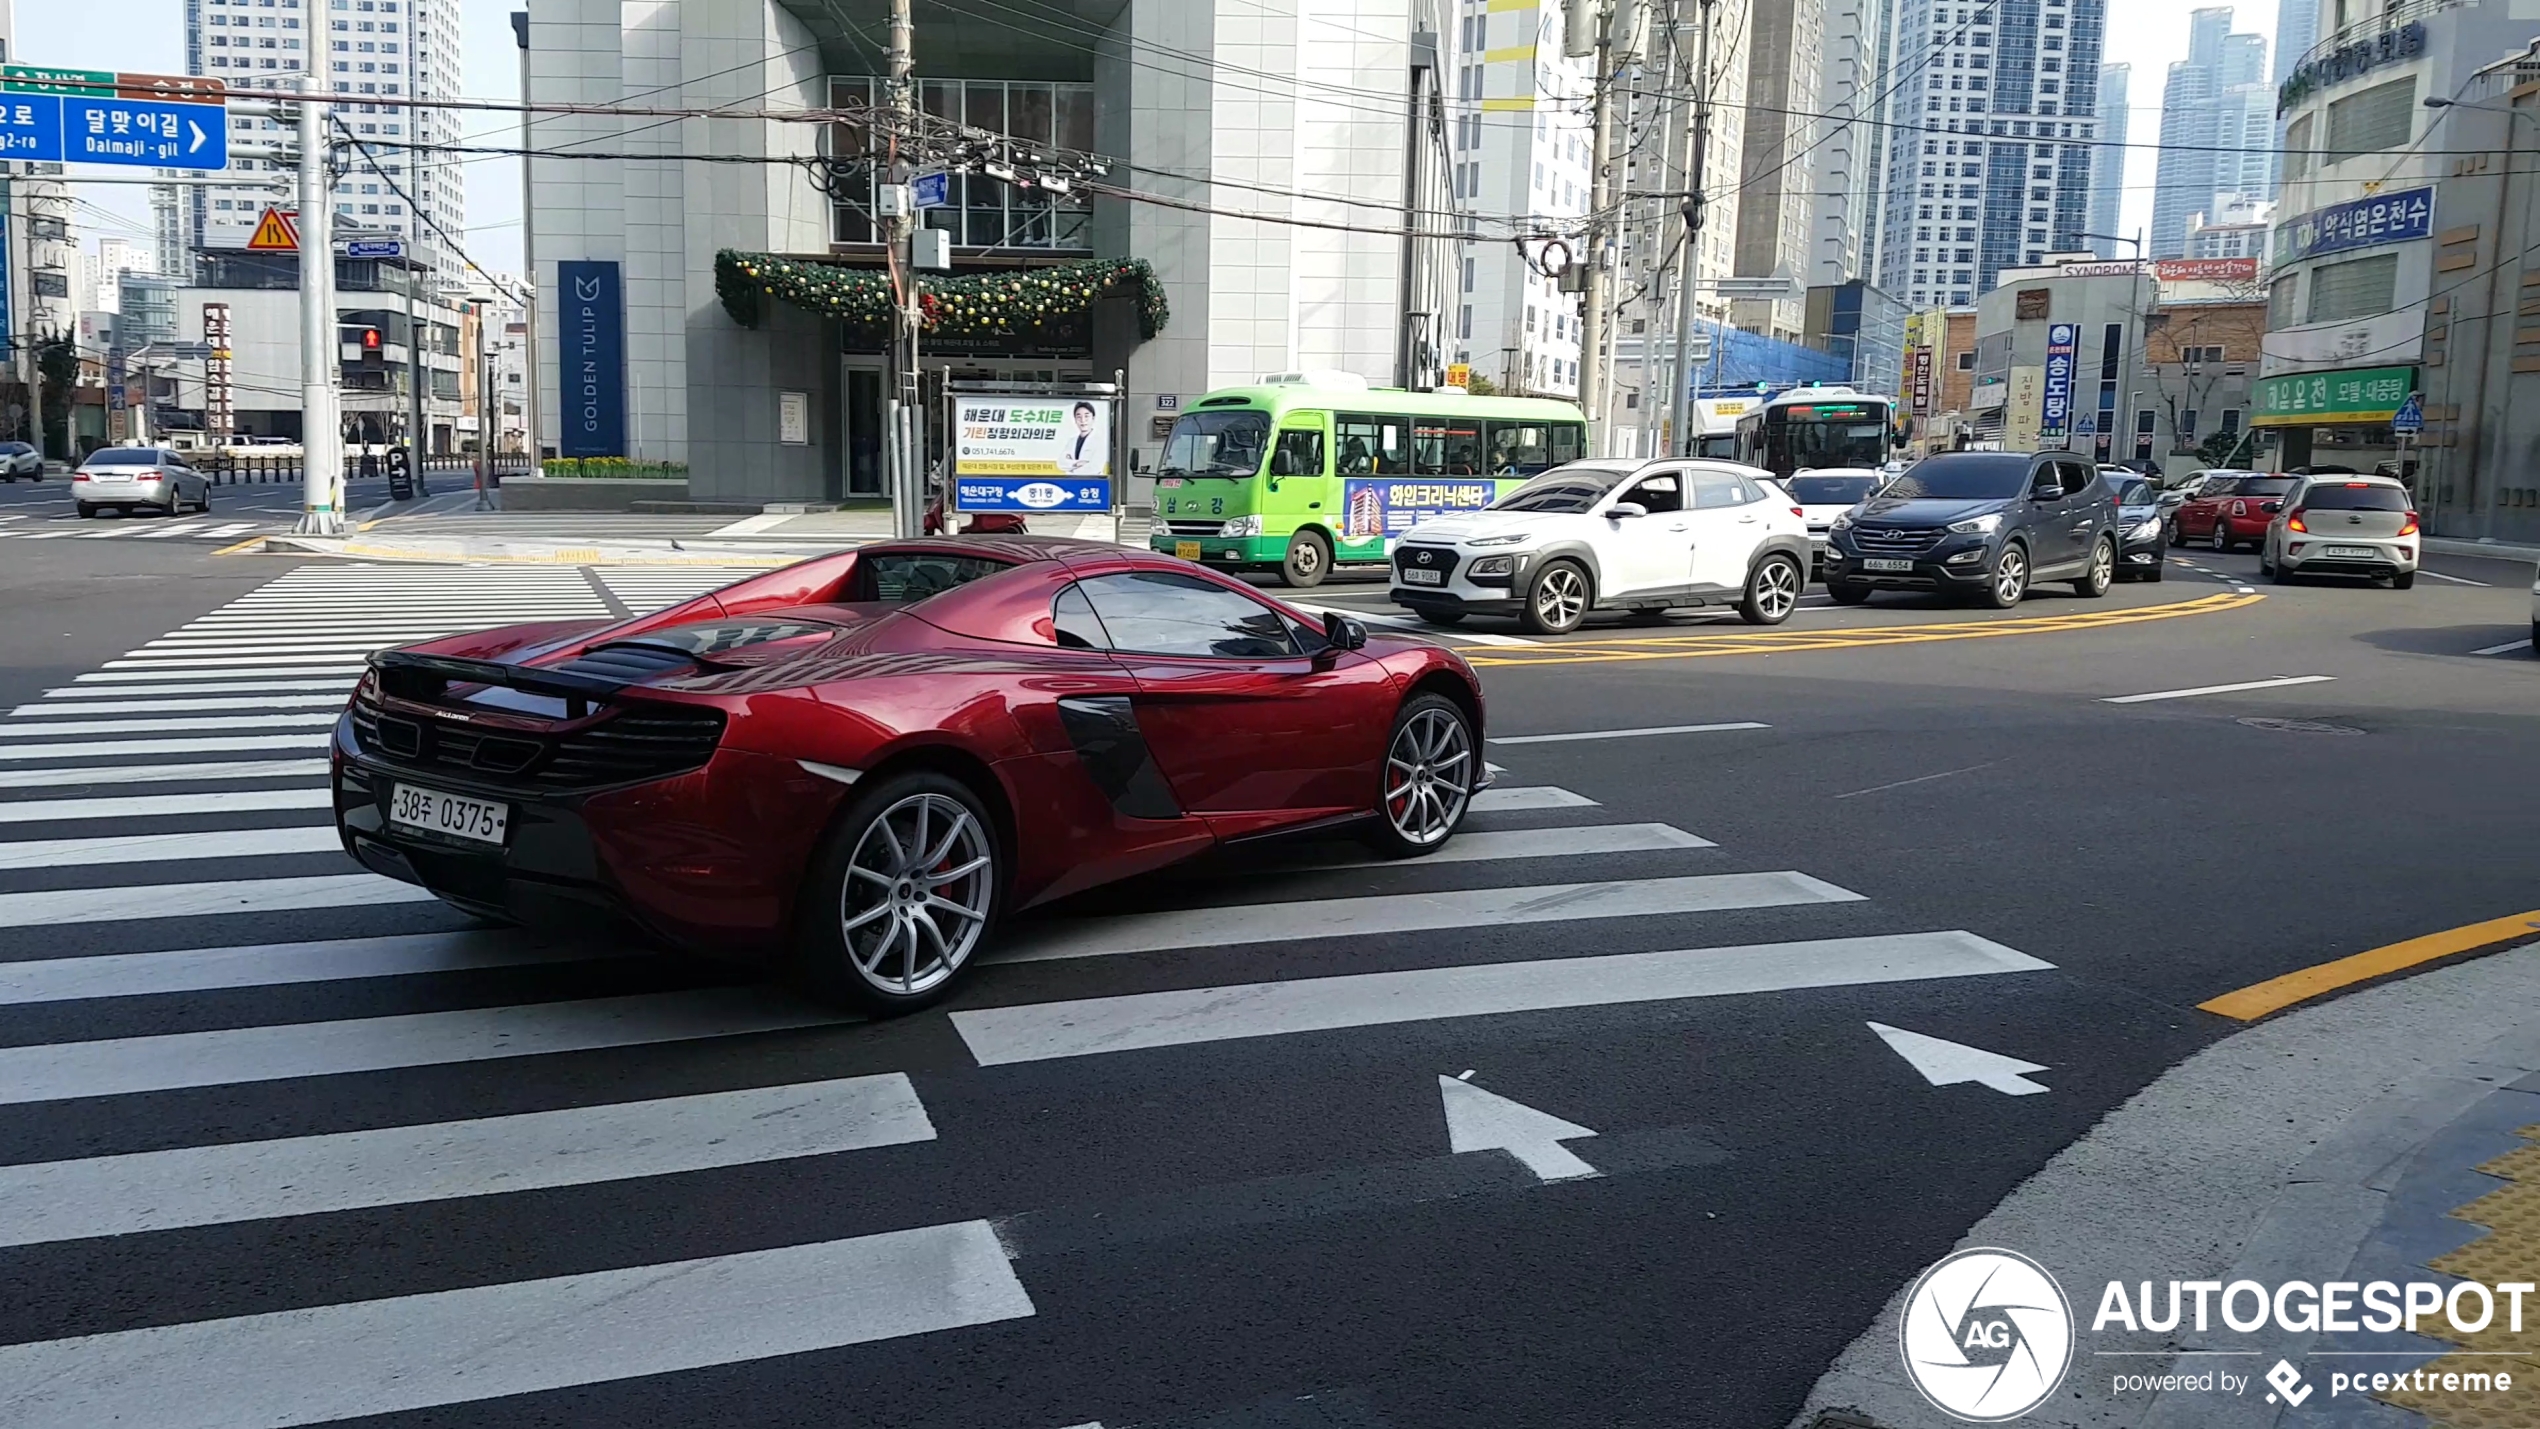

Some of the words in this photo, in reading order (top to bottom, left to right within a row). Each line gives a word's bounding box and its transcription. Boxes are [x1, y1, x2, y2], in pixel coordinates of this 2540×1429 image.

[85, 108, 179, 138] 달맞이길
[582, 306, 596, 356] TULIP
[2046, 355, 2069, 418] 송도탕
[584, 361, 598, 432] GOLDEN
[964, 408, 1006, 423] 해운대
[1009, 409, 1063, 423] 도수치료
[963, 427, 1056, 440] 기린정형외과의원
[391, 453, 403, 465] P
[960, 486, 1003, 498] 해운대구청
[1080, 488, 1099, 499] 송정
[1389, 484, 1484, 506] 화인크리닉센타
[1166, 497, 1176, 513] 삼
[1211, 498, 1223, 514] 강
[1887, 561, 1908, 569] 6554
[399, 789, 432, 823] 38주
[441, 798, 495, 836] 0375
